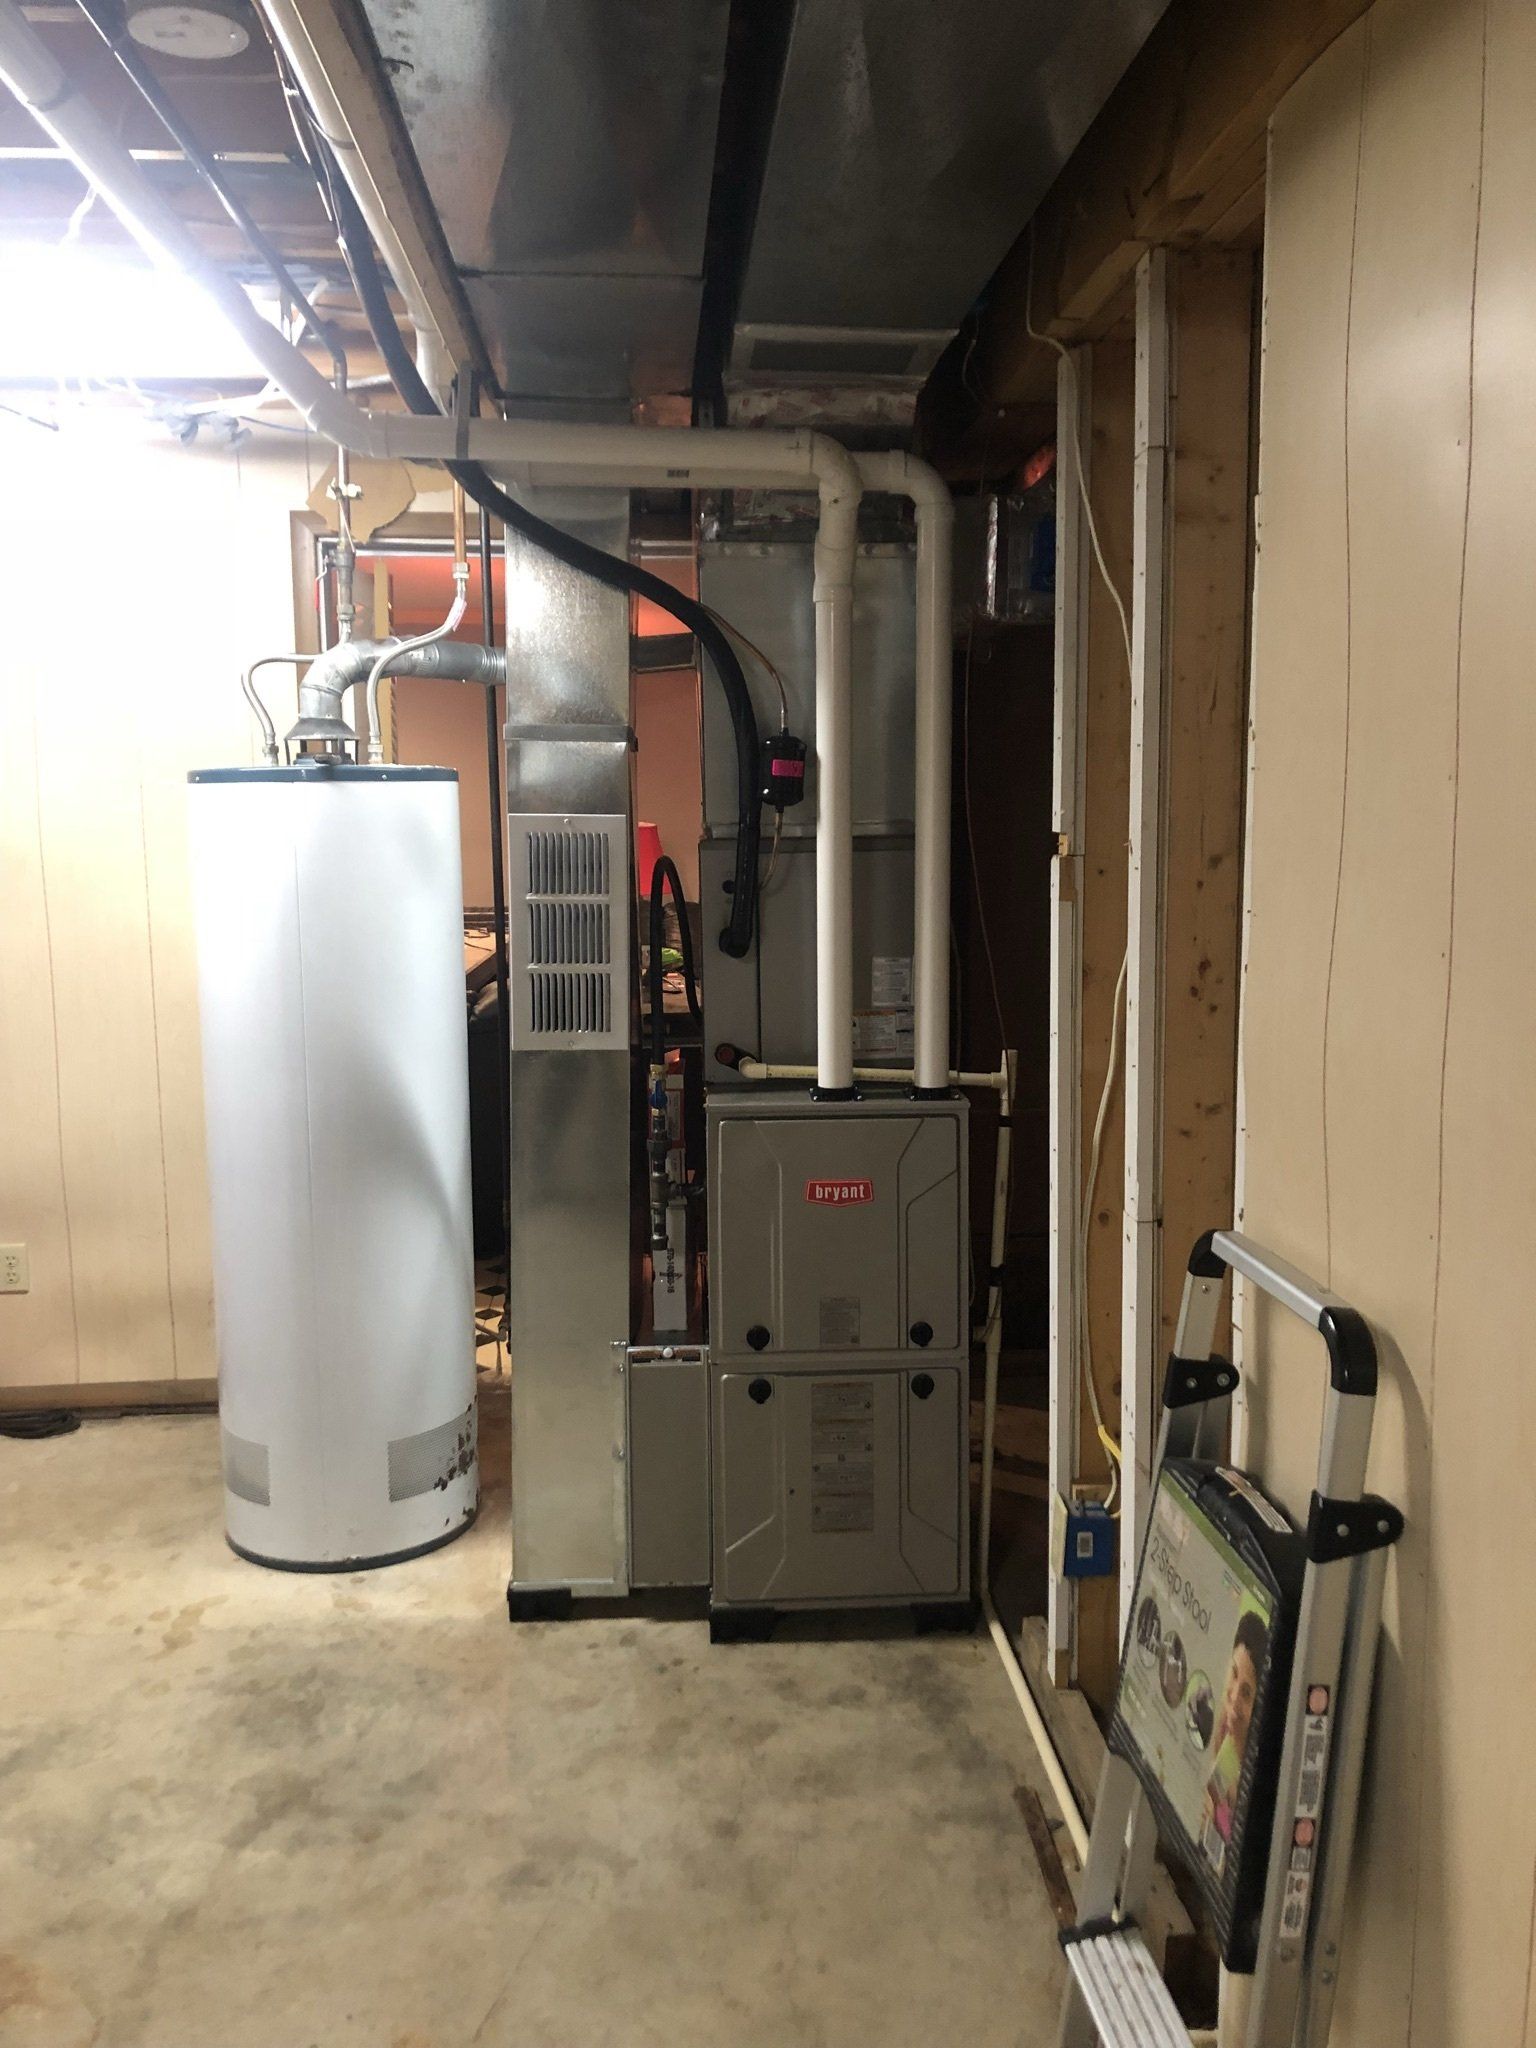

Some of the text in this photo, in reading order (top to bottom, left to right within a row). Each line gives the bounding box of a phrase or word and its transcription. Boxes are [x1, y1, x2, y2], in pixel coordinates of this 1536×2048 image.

[815, 1184, 865, 1201] bryant
[1150, 1537, 1182, 1597] 2-Step
[1182, 1580, 1212, 1635] Stool
